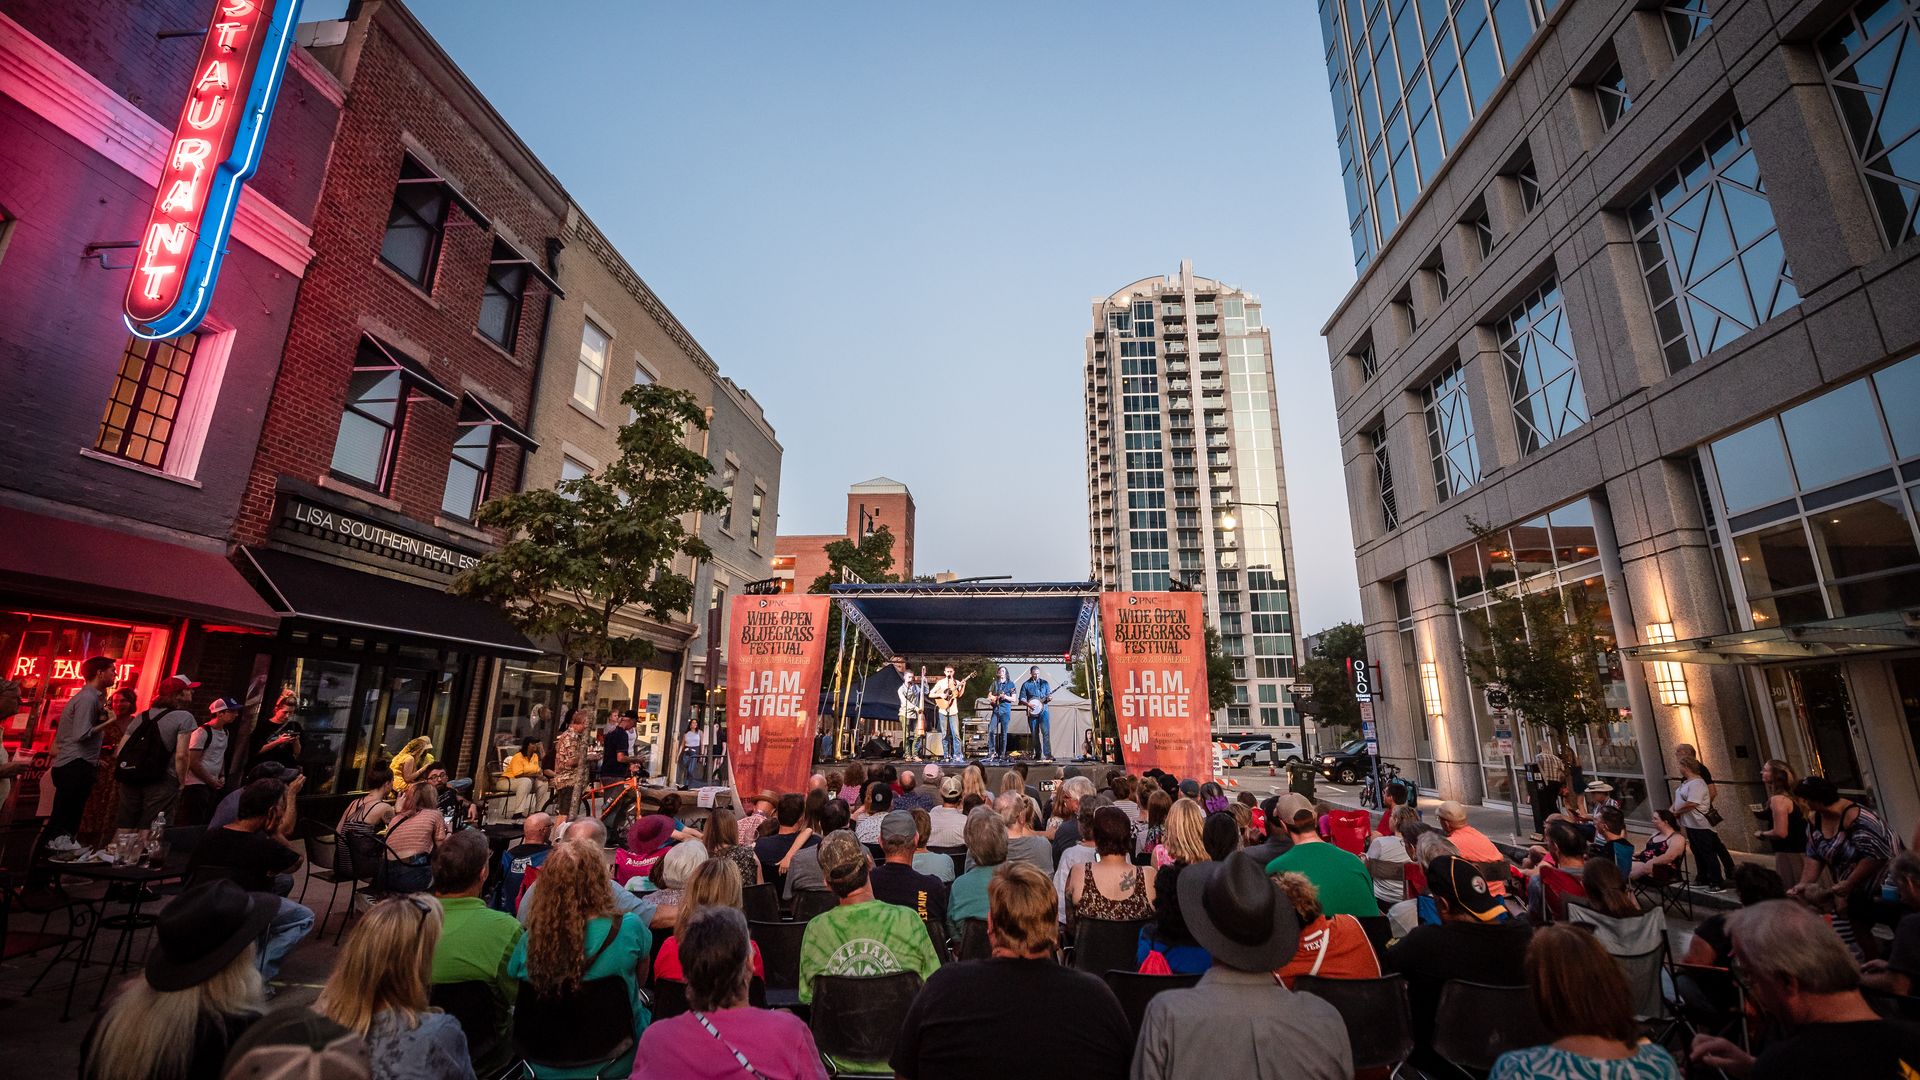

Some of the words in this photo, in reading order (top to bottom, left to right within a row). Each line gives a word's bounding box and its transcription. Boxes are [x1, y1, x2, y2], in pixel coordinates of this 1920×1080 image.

[295, 503, 333, 530] LISA
[339, 518, 419, 555] SOUTHERN
[423, 543, 455, 566] REAL
[459, 554, 484, 569] EST
[1139, 597, 1158, 605] PNC
[747, 610, 778, 626] WIDE
[781, 610, 812, 626] OPEN
[1118, 608, 1151, 624] WIDE
[1154, 608, 1186, 624] OPEN
[741, 626, 815, 644] BLUEGRASS
[1115, 624, 1191, 642] BLUEGRASS
[749, 641, 804, 655] FESTIVAL
[1124, 640, 1182, 654] FESTIVAL
[1163, 655, 1191, 664] RALEIGH
[743, 670, 806, 695] J.A.M.
[1124, 670, 1191, 694] J.A.M.
[1354, 660, 1368, 694] ORO
[1771, 686, 1786, 697] 301
[738, 694, 803, 717] STAGE
[1121, 694, 1190, 717] STAGE
[738, 724, 760, 752] JAM
[1123, 723, 1149, 752] JAM
